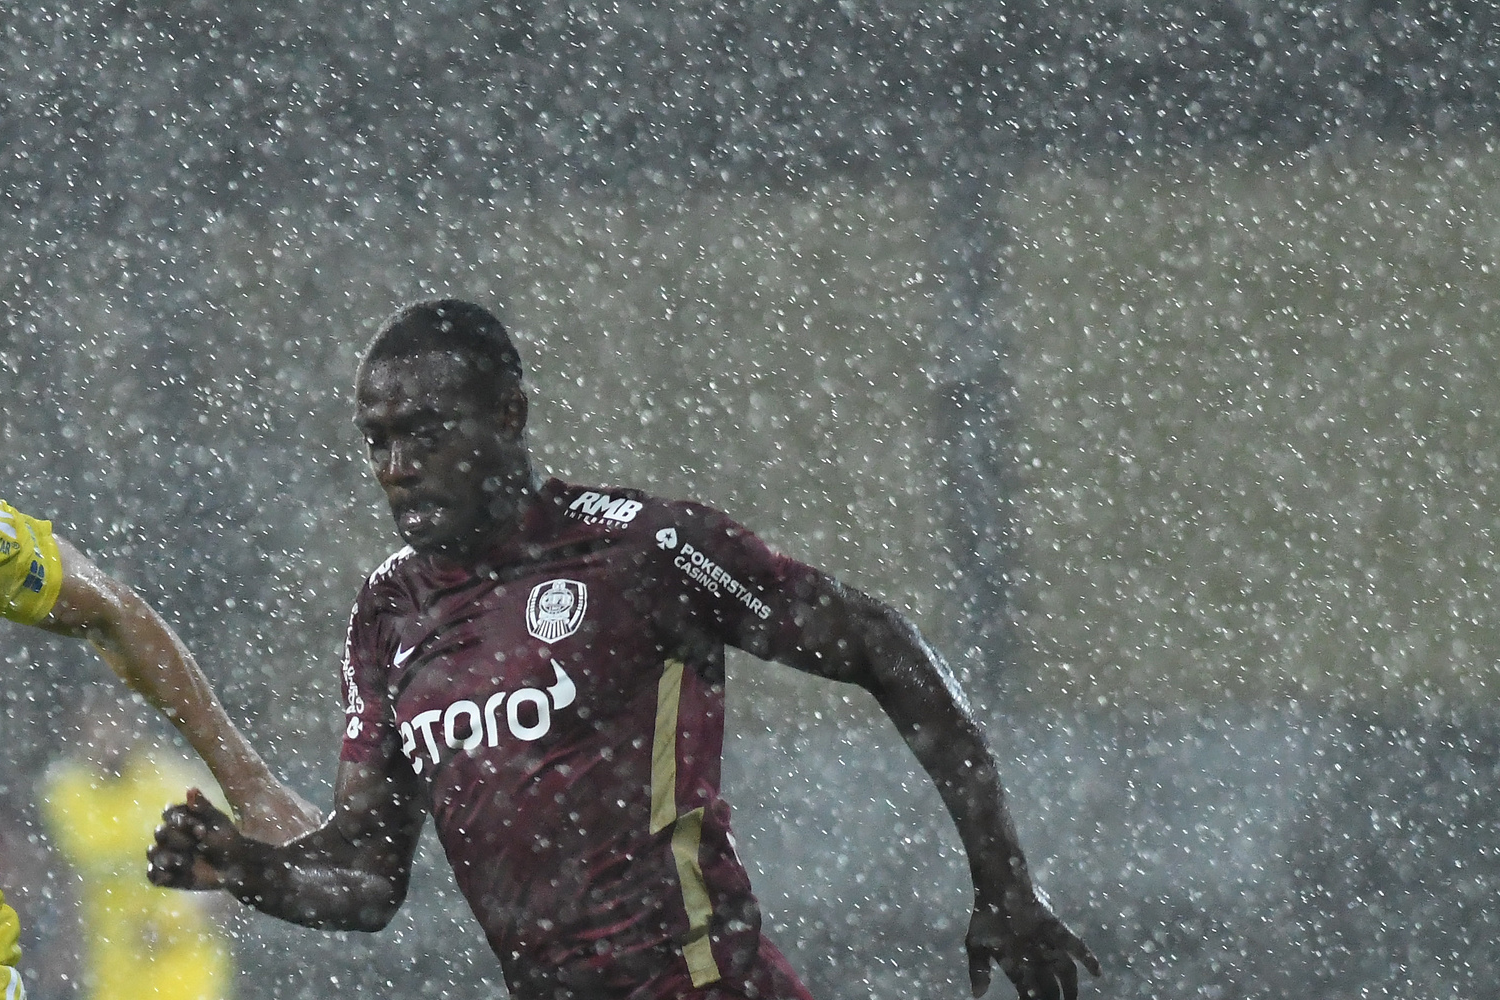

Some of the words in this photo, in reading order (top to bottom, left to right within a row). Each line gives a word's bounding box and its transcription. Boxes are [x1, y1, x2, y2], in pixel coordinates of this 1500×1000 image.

[569, 491, 643, 523] RMB
[673, 556, 719, 593] CASINO
[679, 543, 773, 620] POKERSTARS
